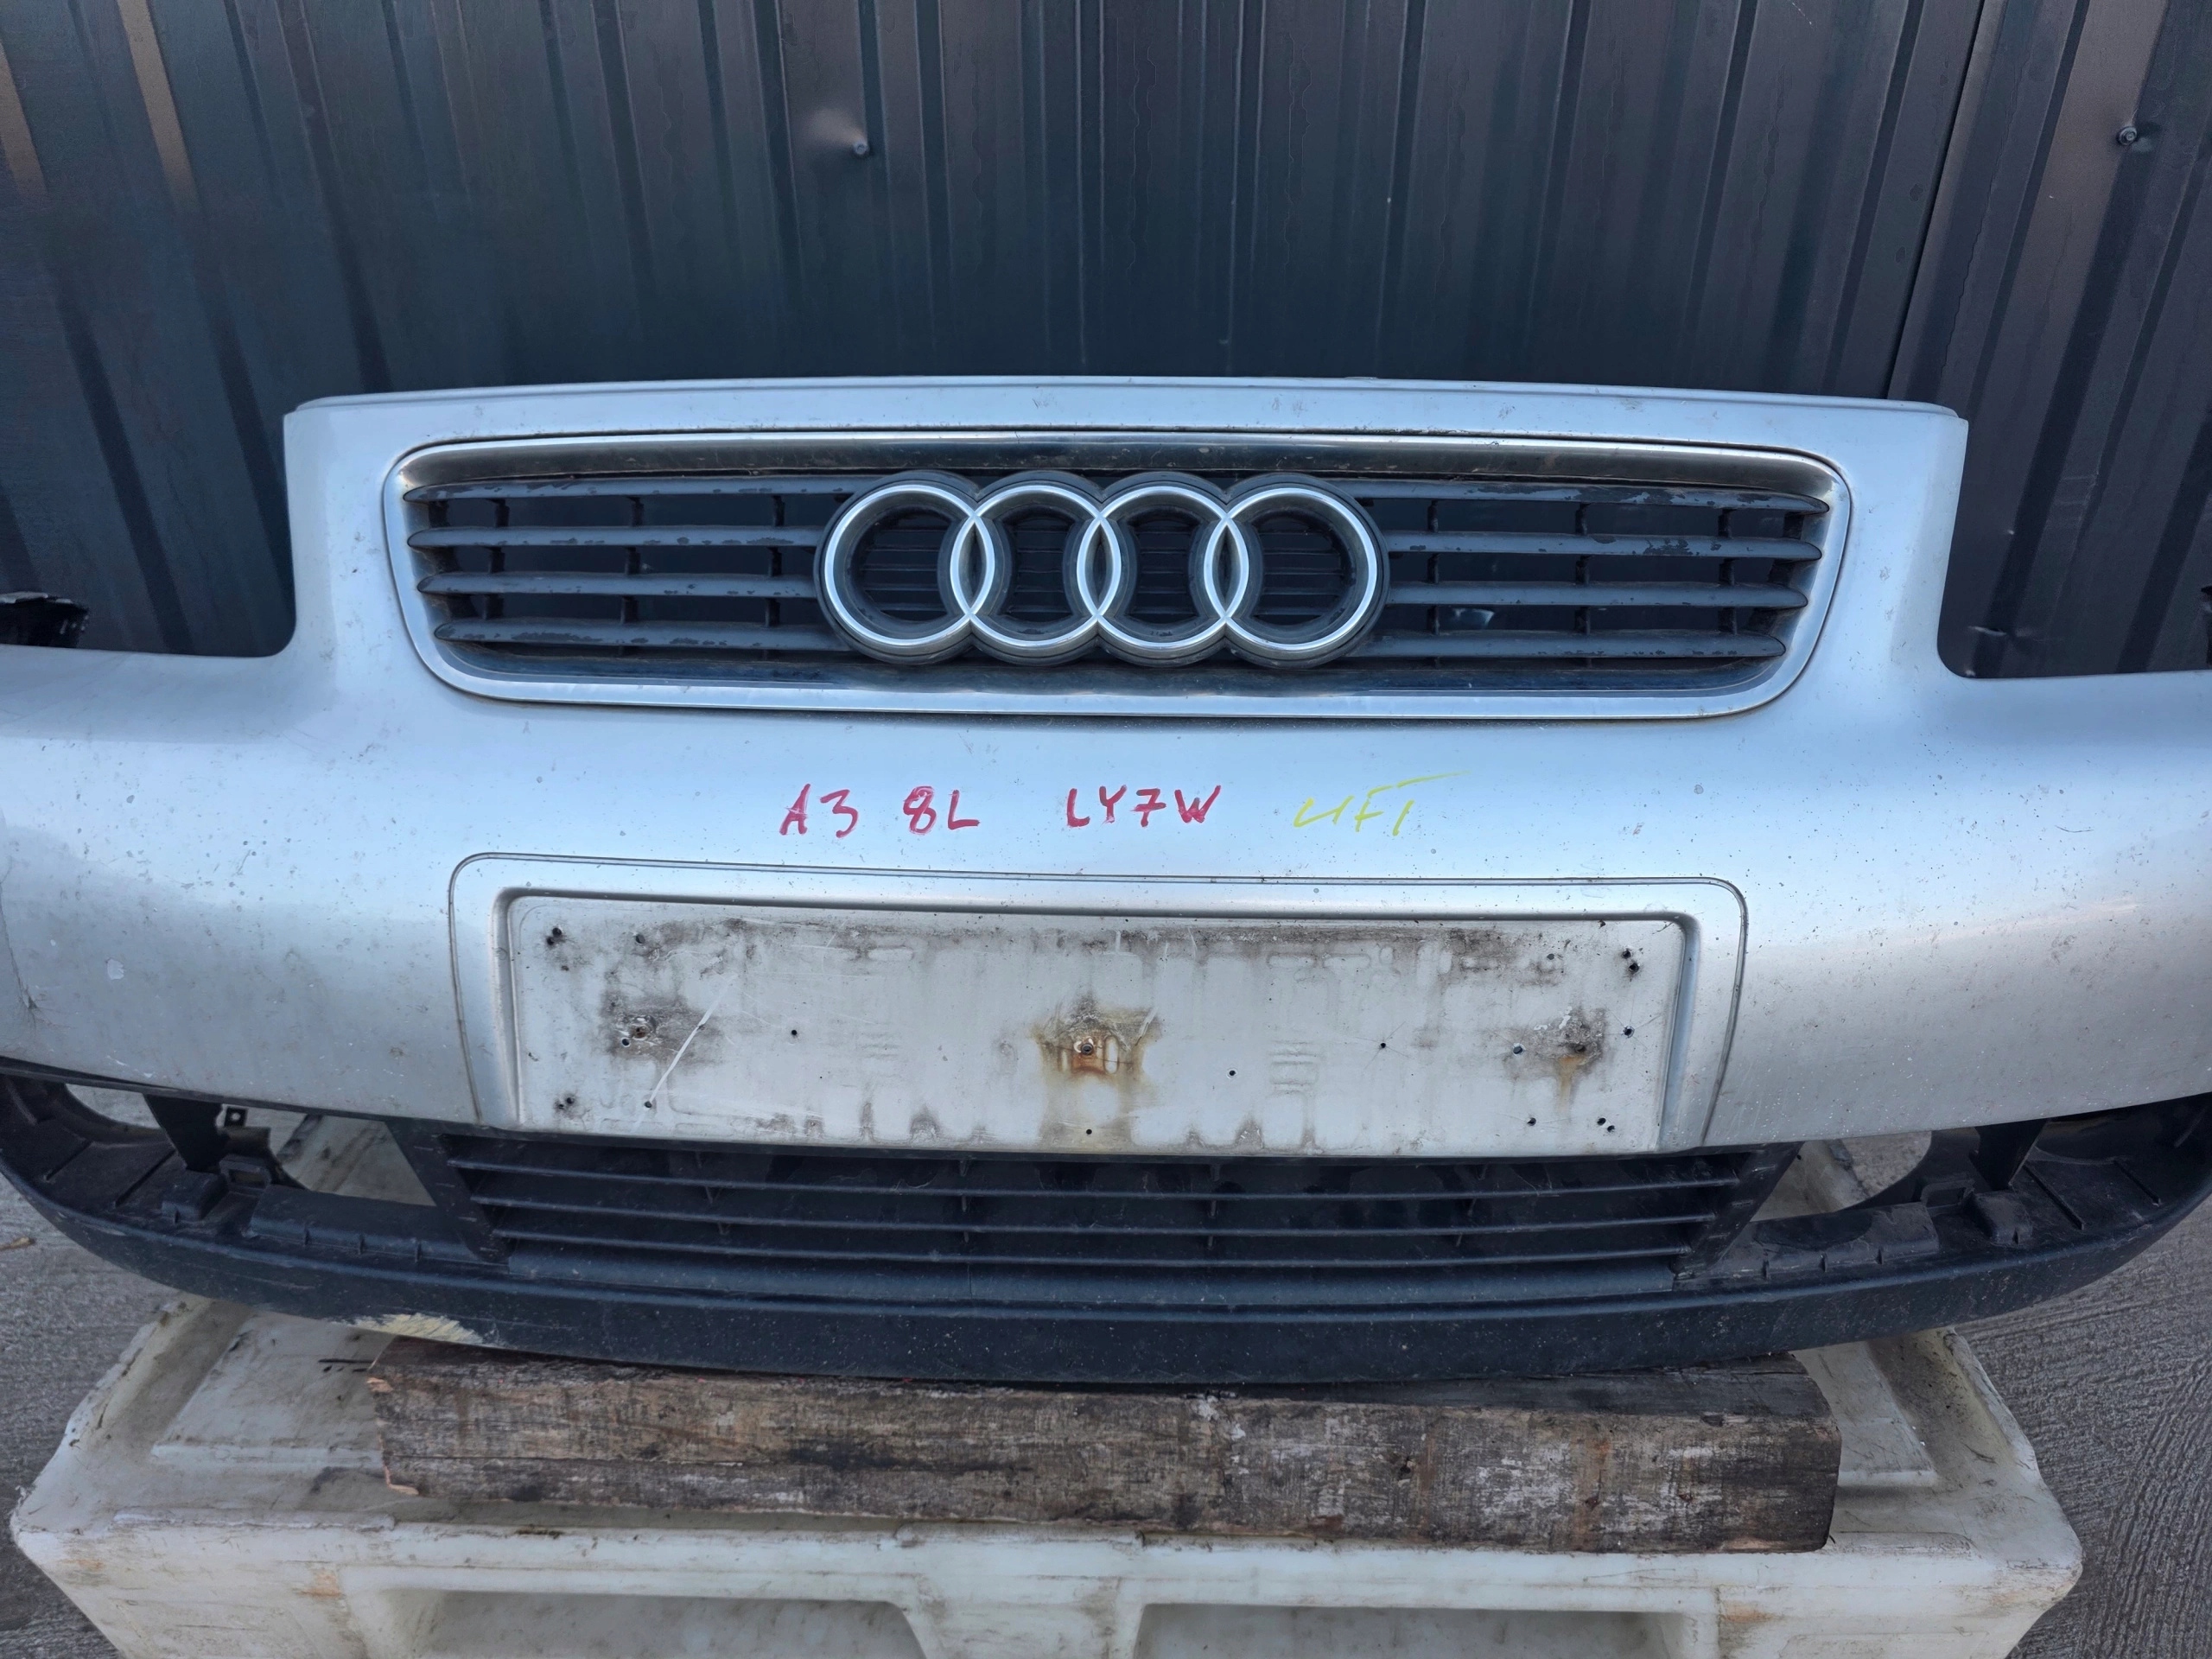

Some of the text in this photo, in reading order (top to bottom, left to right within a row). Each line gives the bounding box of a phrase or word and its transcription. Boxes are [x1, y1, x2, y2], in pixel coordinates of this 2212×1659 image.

[781, 785, 857, 837] A3
[904, 786, 980, 834] 8L
[1067, 785, 1221, 829] LY7W
